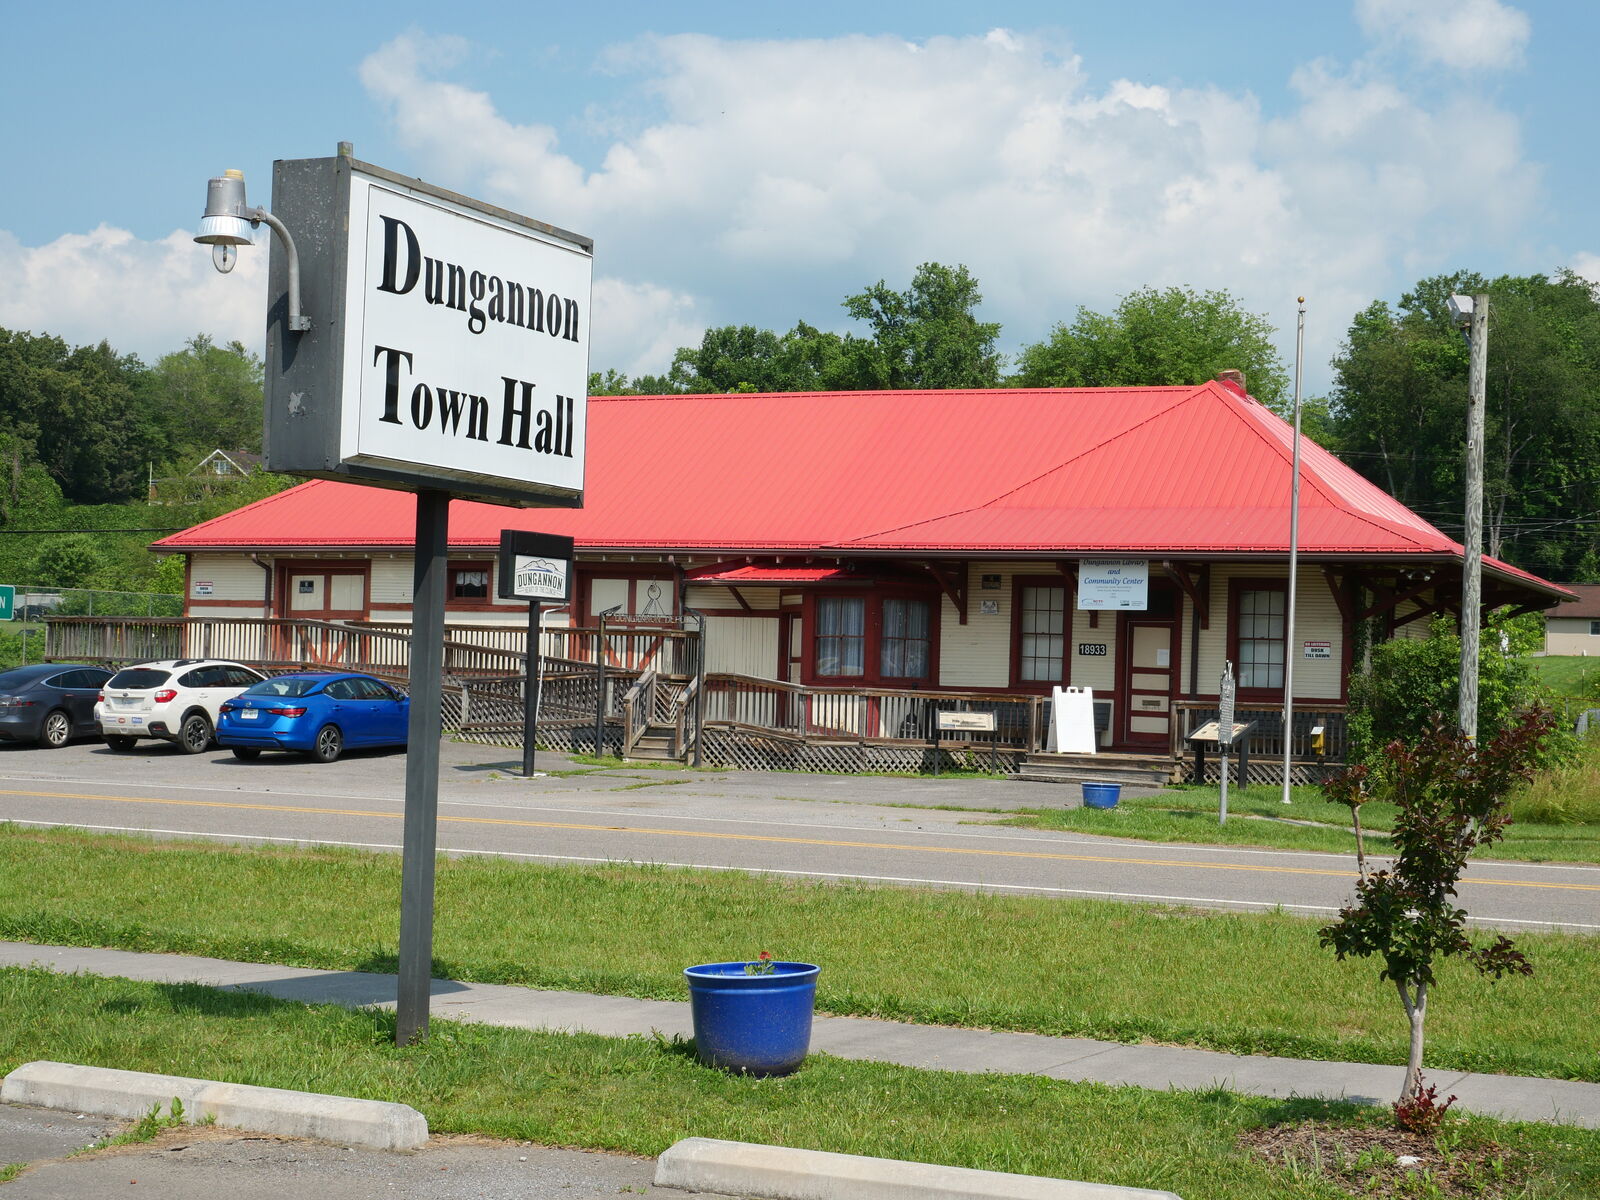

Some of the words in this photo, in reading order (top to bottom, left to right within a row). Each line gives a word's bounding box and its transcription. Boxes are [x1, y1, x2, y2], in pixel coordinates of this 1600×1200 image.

[377, 214, 579, 343] Dungannon
[373, 345, 489, 442] Town
[496, 376, 574, 458] Hall
[517, 572, 563, 590] DUNGANNON
[1083, 577, 1121, 585] Community
[1122, 577, 1145, 585] Center
[1080, 644, 1106, 655] 18933
